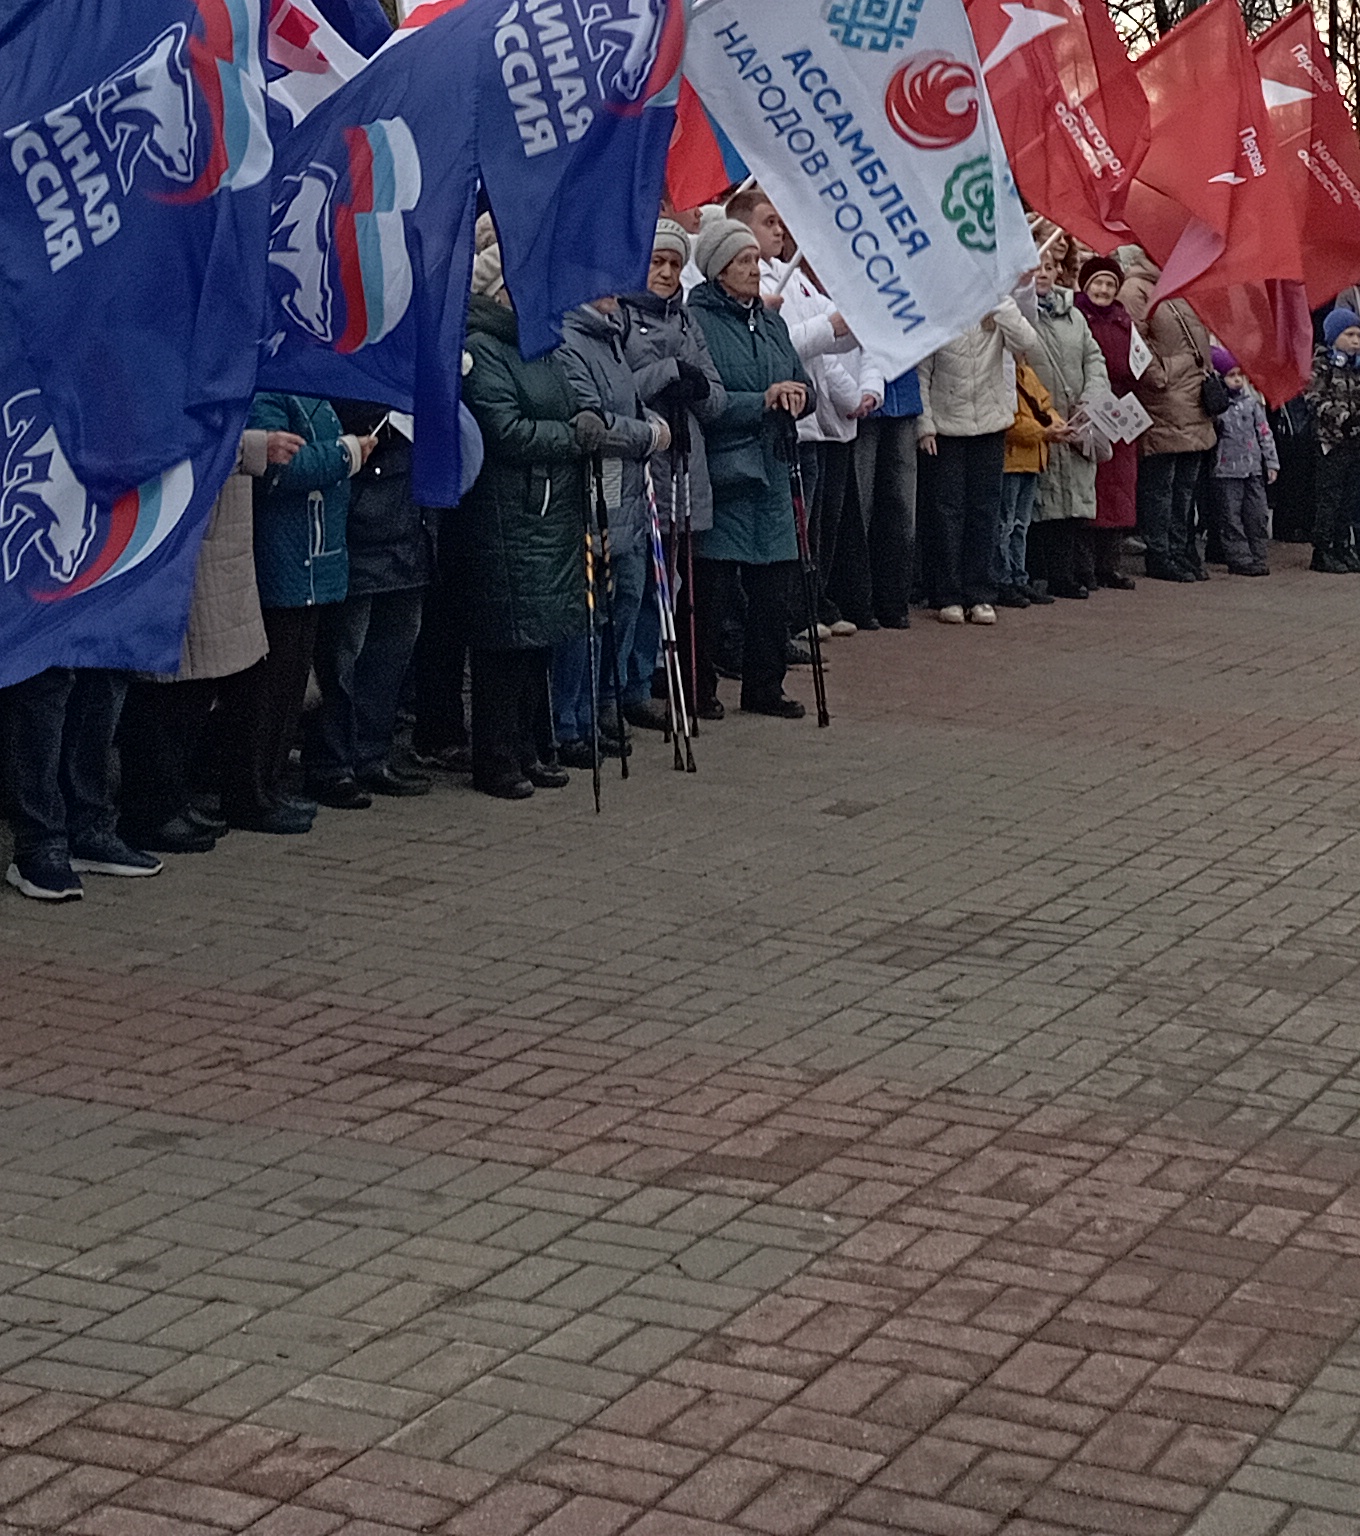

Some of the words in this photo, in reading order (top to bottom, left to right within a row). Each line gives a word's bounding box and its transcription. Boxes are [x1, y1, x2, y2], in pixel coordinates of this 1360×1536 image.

[5, 120, 83, 275] ССИЯ
[43, 100, 121, 247] ИНАЯ
[713, 20, 830, 177] НАРОДОВ
[818, 179, 927, 335] РОССИИ
[781, 47, 931, 260] АССАМБЛЕЯ
